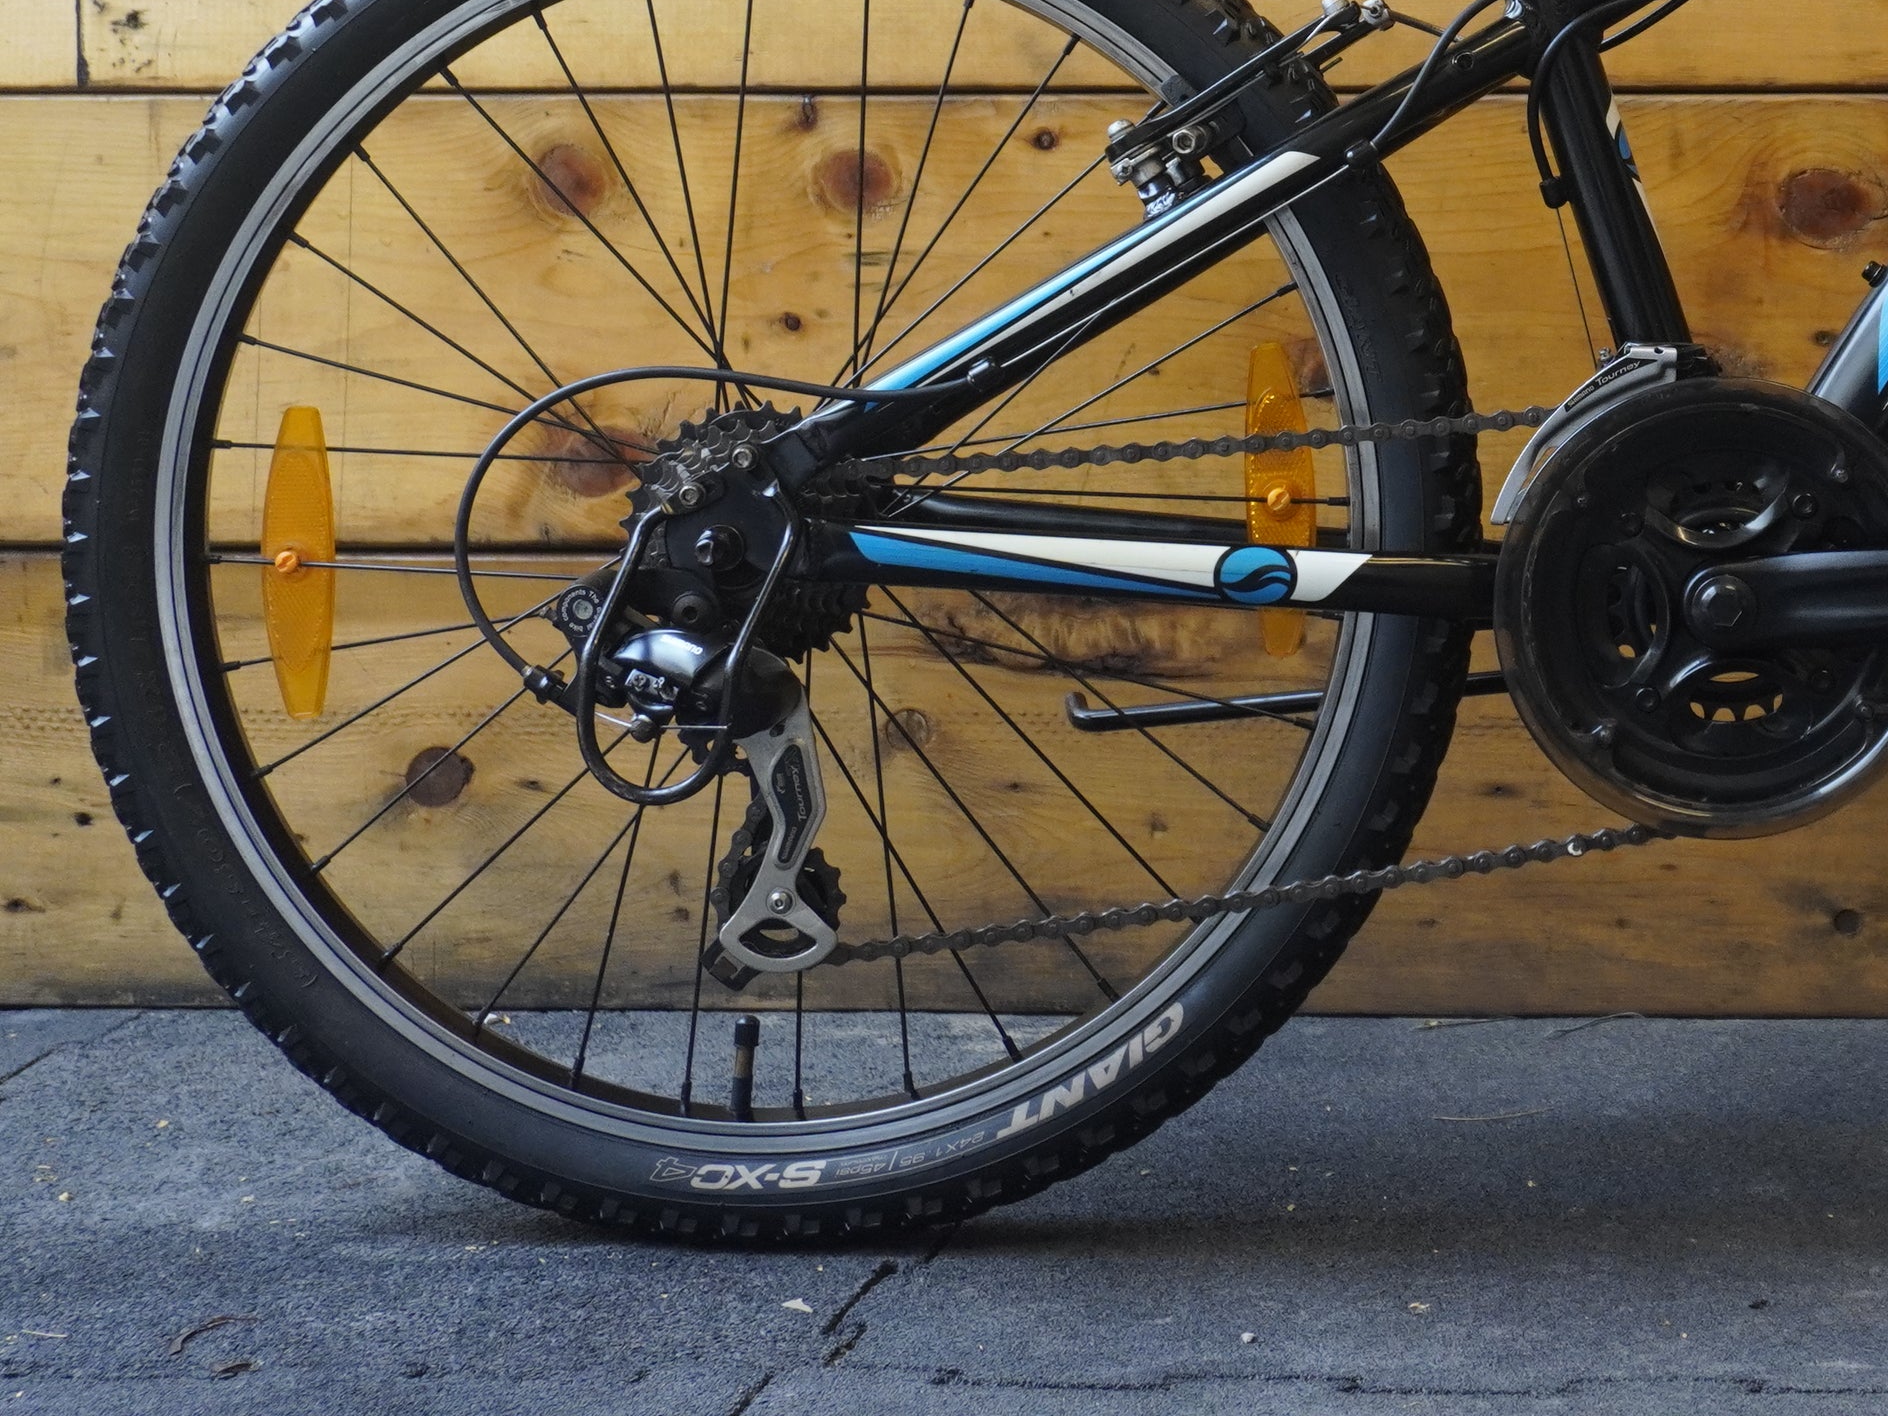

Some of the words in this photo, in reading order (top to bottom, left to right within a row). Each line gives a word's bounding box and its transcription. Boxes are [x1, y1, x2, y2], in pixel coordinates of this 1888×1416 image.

[1595, 360, 1641, 386] Tourney
[790, 765, 808, 822] Tourney
[996, 1002, 1185, 1139] GIANT
